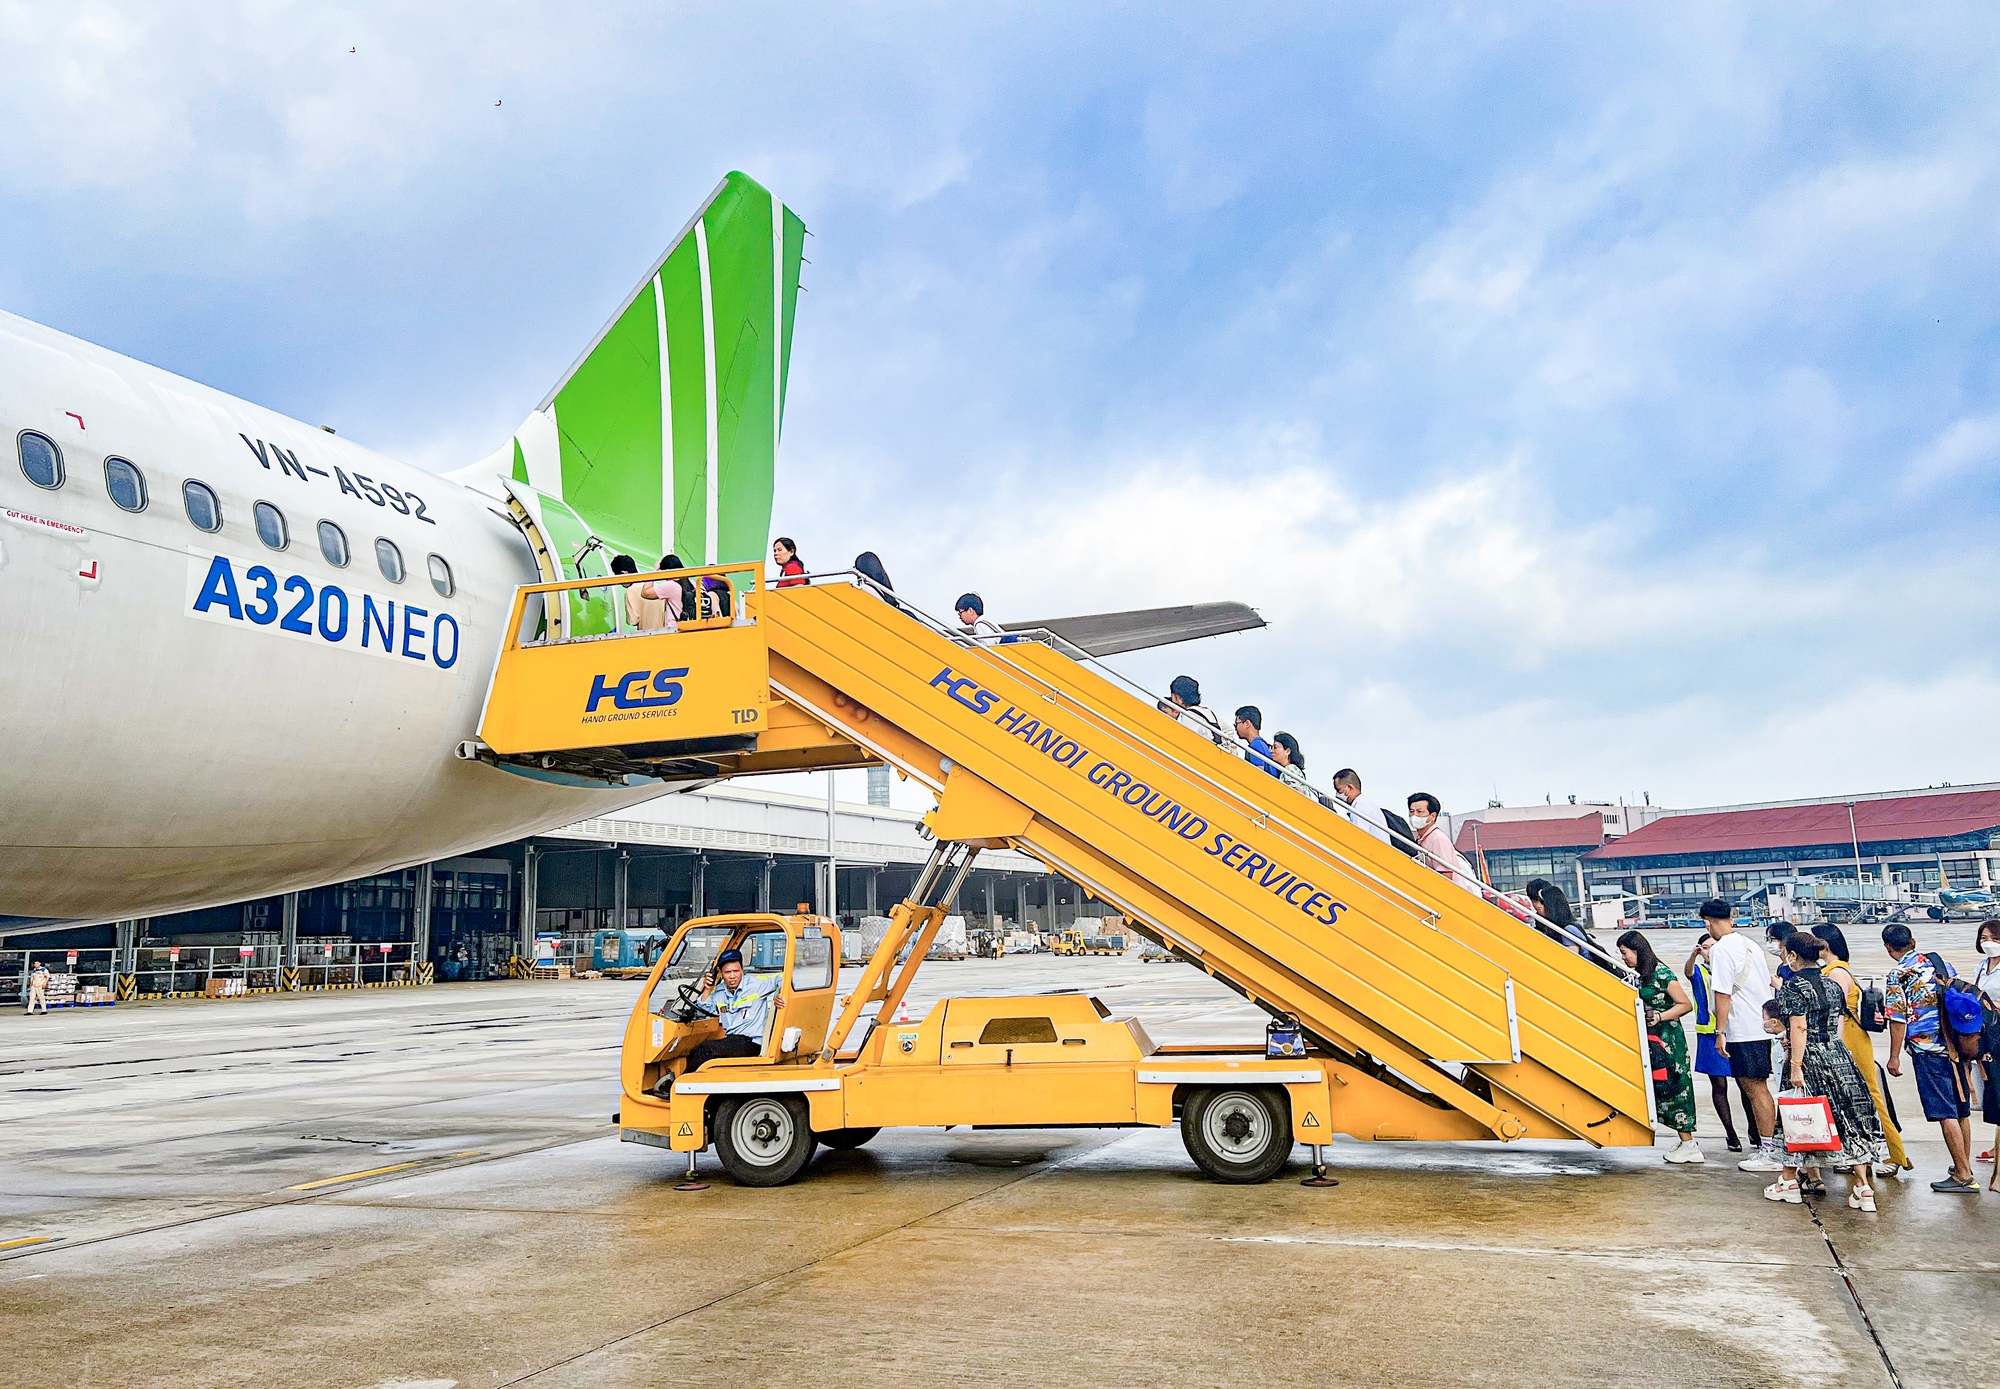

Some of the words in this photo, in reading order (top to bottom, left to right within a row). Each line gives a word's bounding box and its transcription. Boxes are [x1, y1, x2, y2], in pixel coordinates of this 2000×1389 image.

[238, 432, 436, 525] VN-A592
[6, 510, 20, 519] CUT
[20, 513, 38, 523] HERE
[46, 520, 85, 534] EMERGENCY
[192, 555, 349, 642] A320
[361, 594, 459, 669] NEO
[581, 714, 606, 724] HANOI
[607, 711, 640, 722] GROUND
[642, 708, 678, 719] SERVICES
[731, 708, 759, 724] TLD
[994, 706, 1089, 769] HANOI
[1087, 762, 1209, 840] GROUND
[1203, 833, 1348, 925] SERVICES
